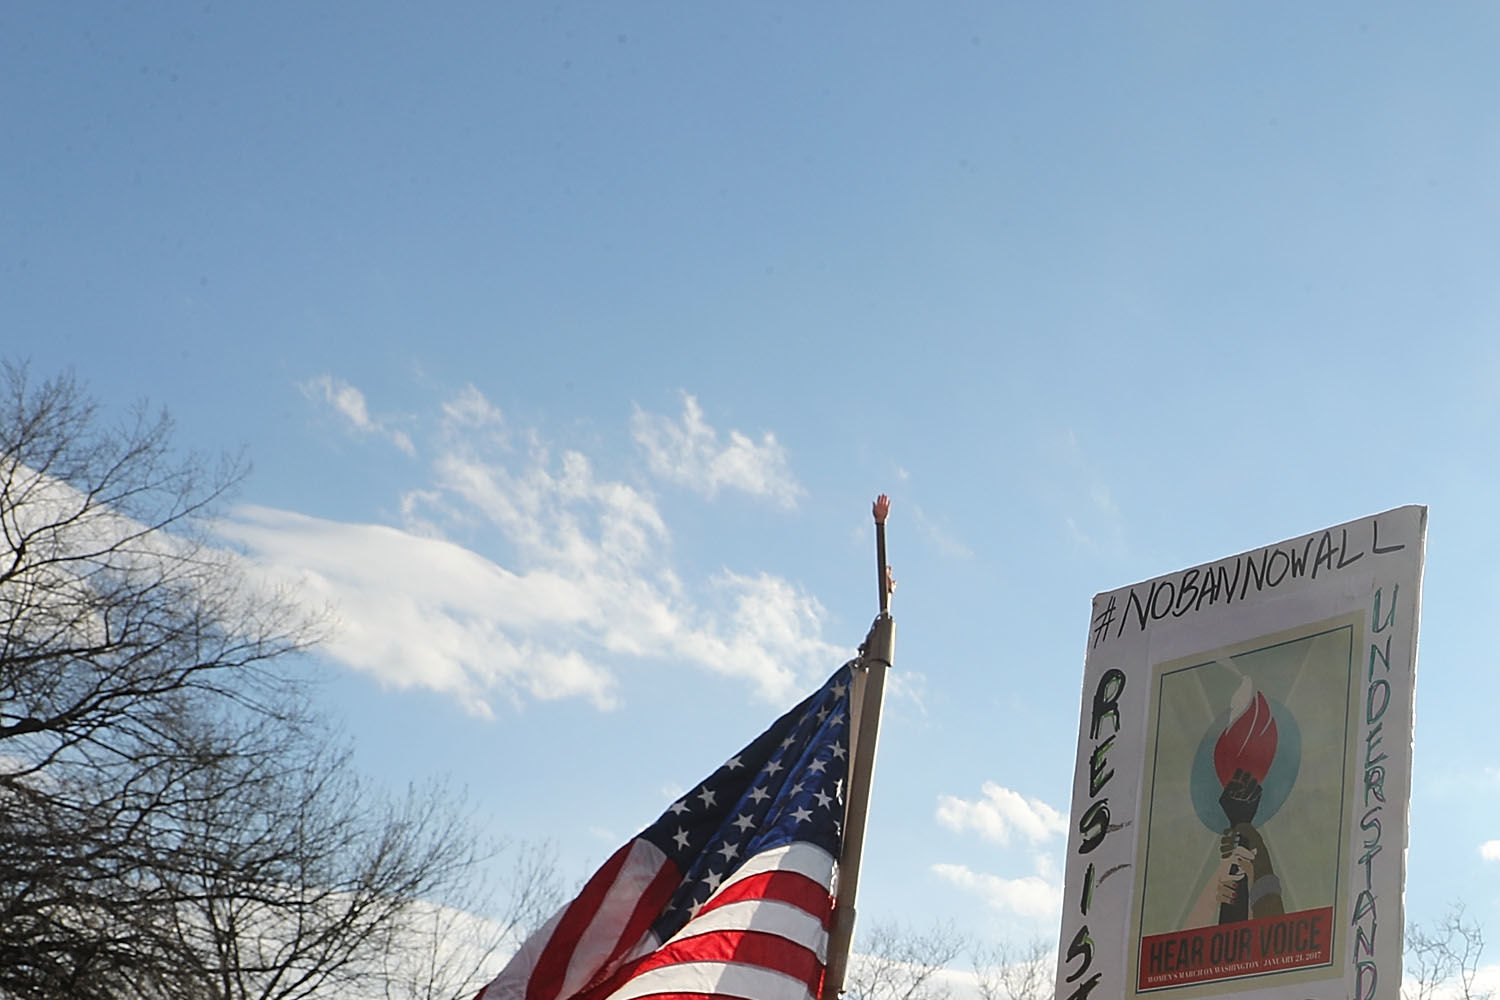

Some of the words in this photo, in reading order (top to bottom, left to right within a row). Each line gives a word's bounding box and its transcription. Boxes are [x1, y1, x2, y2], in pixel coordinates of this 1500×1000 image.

[1094, 520, 1405, 649] #NOBANNOWALL
[1150, 935, 1206, 973] HEAR
[1210, 928, 1254, 965] OUR
[1179, 969, 1203, 979] MARCH
[1203, 967, 1215, 976] ON
[1215, 960, 1259, 975] WASHINGTON
[1263, 956, 1294, 968] JANUARY
[1306, 951, 1322, 961] 2017
